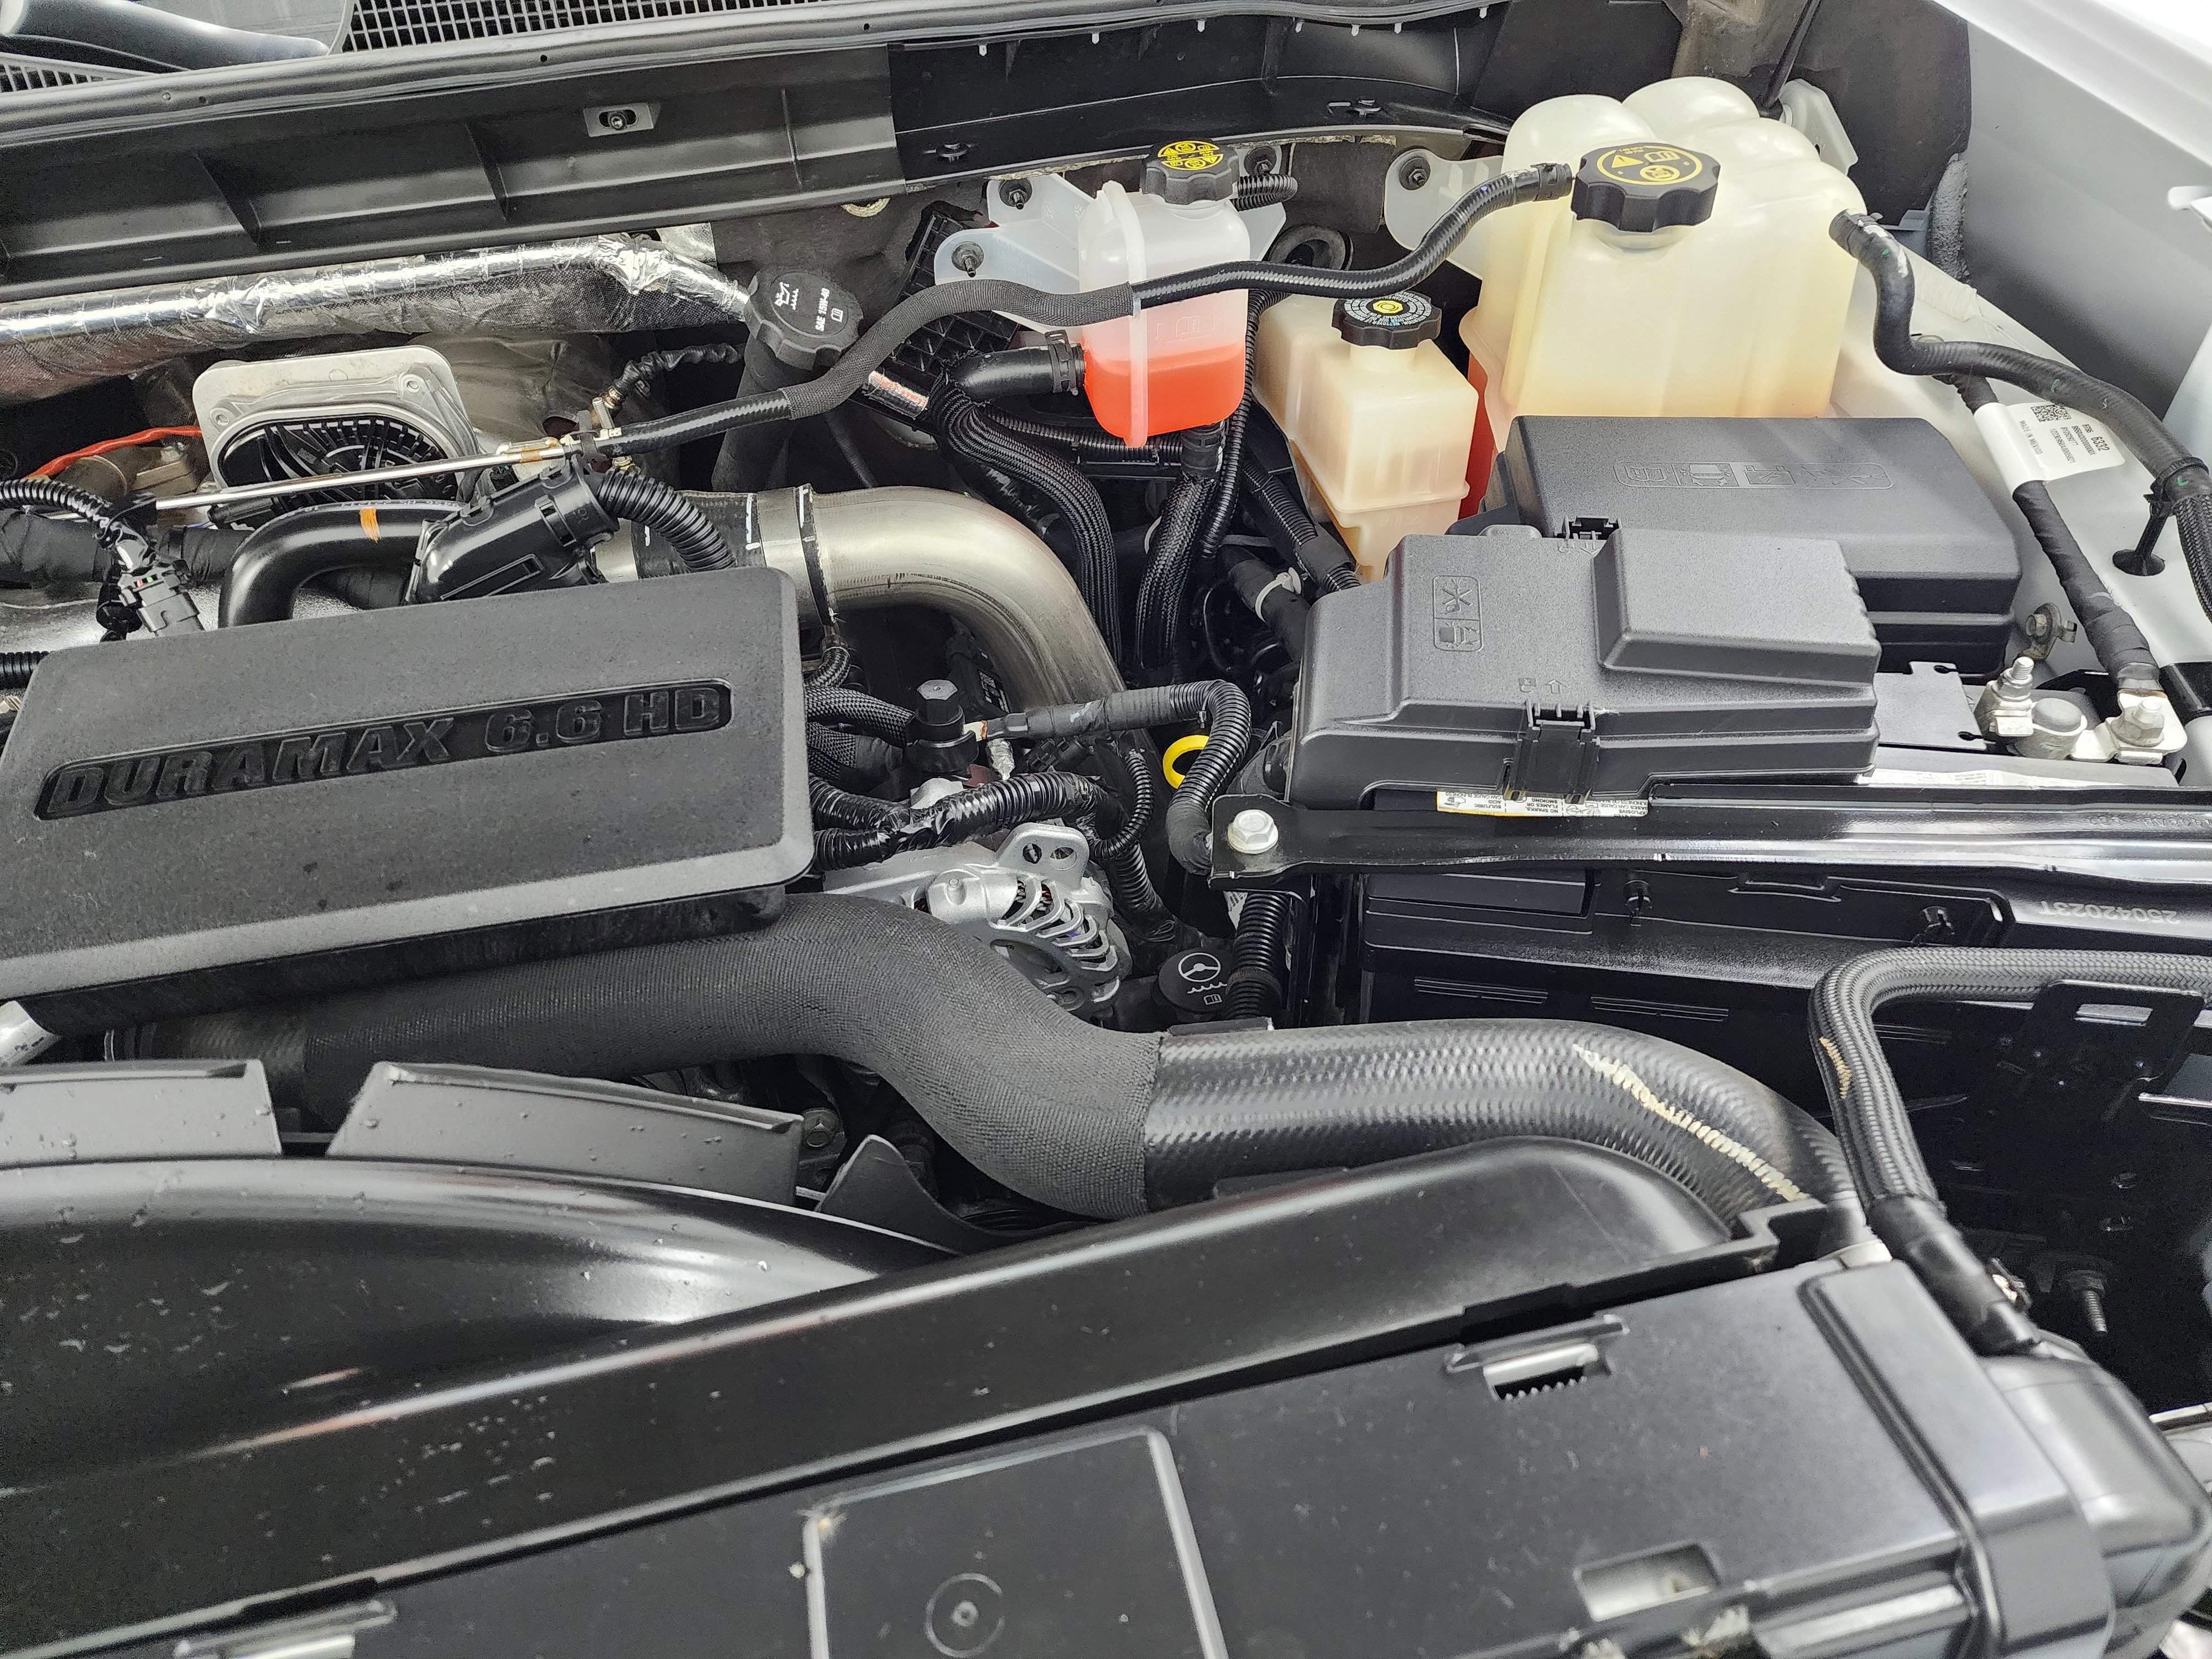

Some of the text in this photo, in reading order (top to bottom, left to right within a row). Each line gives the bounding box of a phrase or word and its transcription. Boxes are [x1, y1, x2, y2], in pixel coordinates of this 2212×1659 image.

[815, 315, 826, 331] SAE
[2019, 420, 2031, 432] MADE
[2029, 436, 2043, 455] MEXICO
[2091, 437, 2110, 451] 6332
[47, 687, 719, 812] DURAMAX 6.6 HD
